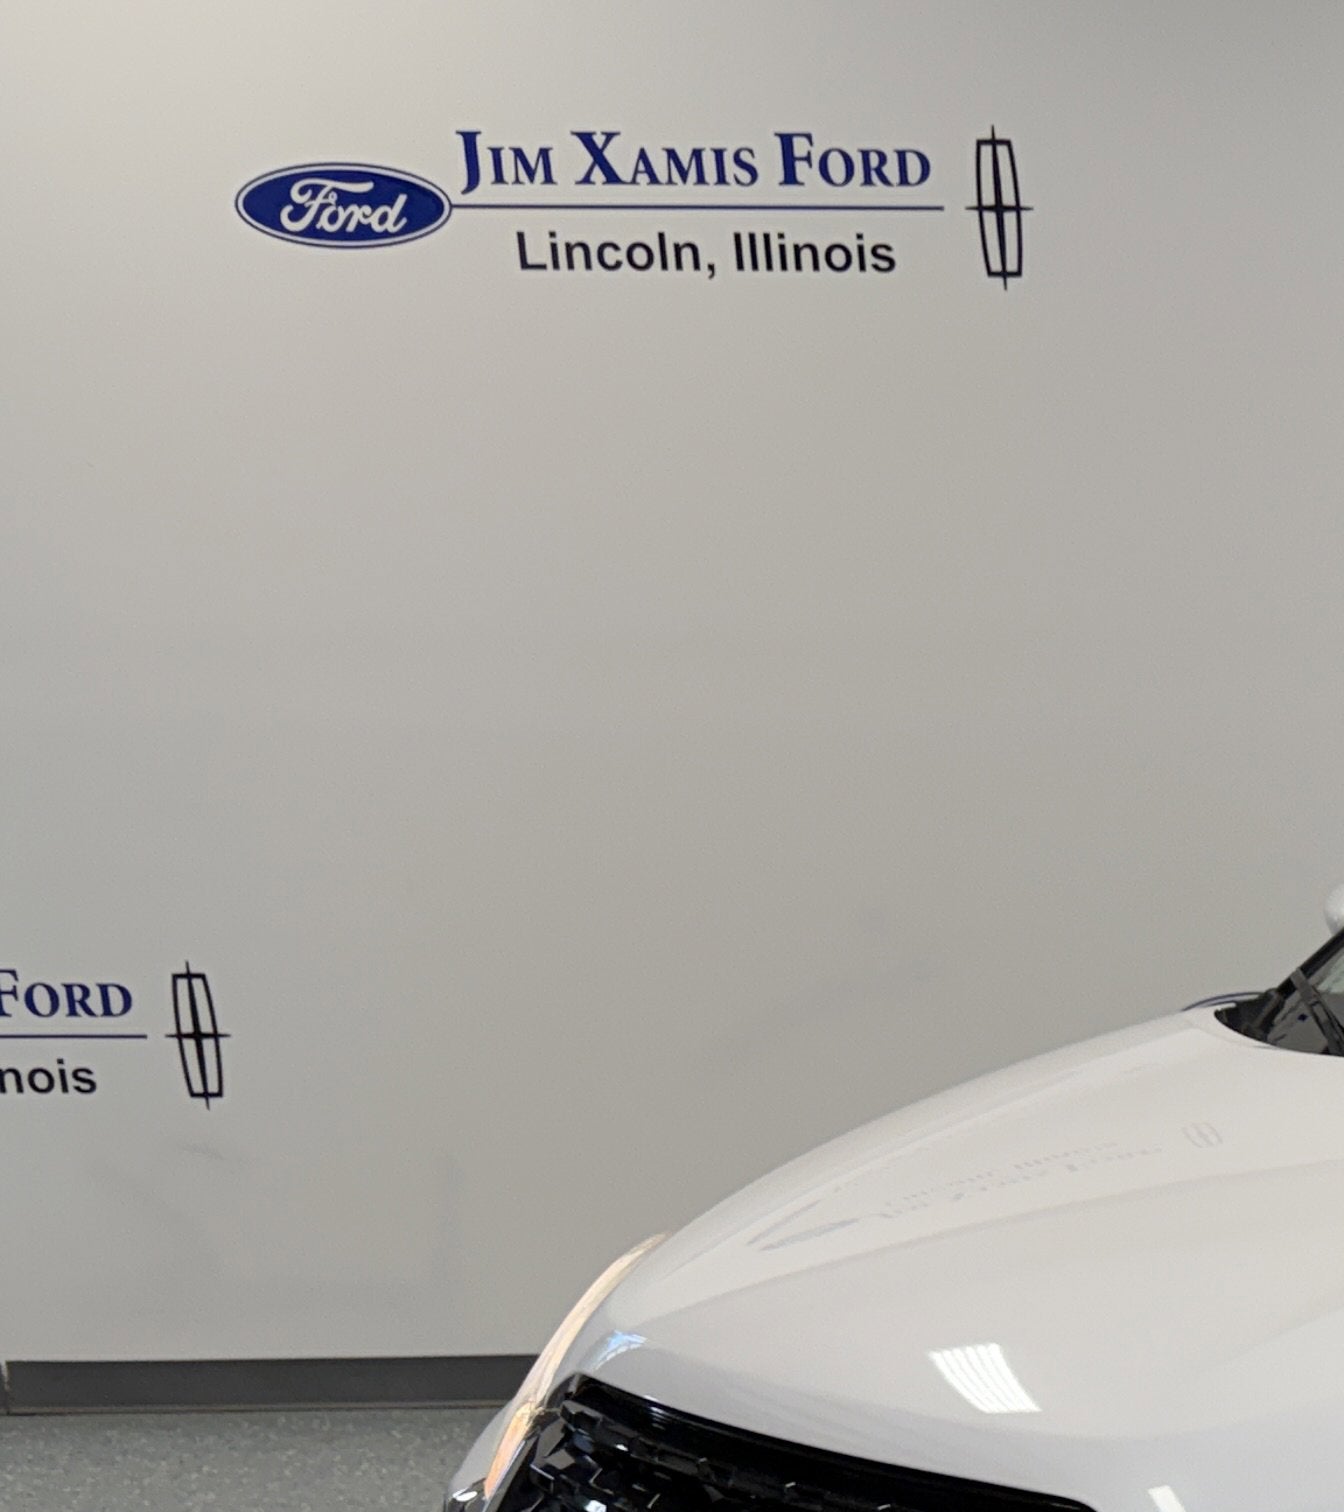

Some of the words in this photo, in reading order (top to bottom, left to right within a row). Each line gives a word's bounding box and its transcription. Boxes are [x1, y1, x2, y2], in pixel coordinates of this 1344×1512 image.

[455, 130, 557, 195] JIM
[571, 131, 759, 187] XAMIS
[774, 132, 932, 187] FORD
[279, 177, 408, 234] Ford
[516, 231, 716, 280] Lincoln,
[733, 231, 896, 273] Illinois
